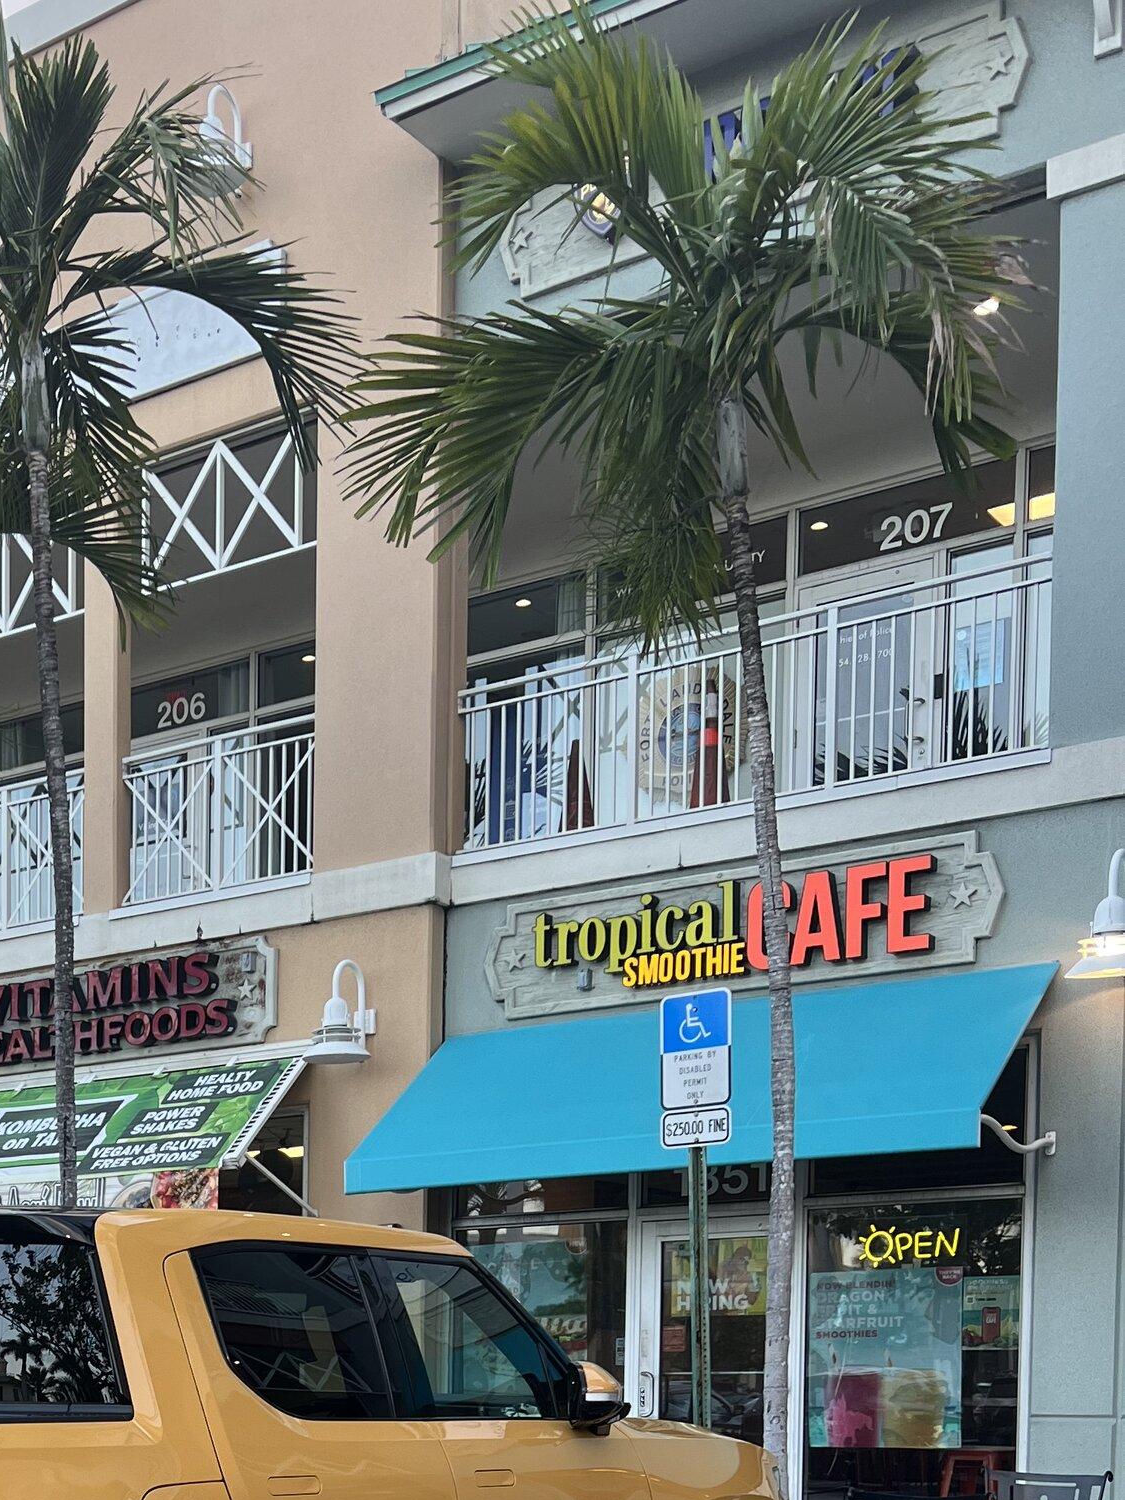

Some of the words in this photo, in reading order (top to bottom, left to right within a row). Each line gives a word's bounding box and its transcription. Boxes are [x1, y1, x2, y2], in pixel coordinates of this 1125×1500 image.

[879, 502, 953, 552] 207
[157, 692, 206, 729] 206
[746, 854, 934, 971] CAFE
[532, 880, 739, 973] tropical
[622, 941, 745, 987] SMOOTHIE
[674, 1052, 703, 1063] PARKING
[707, 1050, 717, 1058] BY
[195, 1069, 257, 1087] HEALTY
[679, 1064, 712, 1075] DISABLED
[167, 1087, 215, 1101] HOME
[217, 1080, 264, 1094] FOOD
[683, 1077, 707, 1087] PERMIT
[687, 1090, 704, 1100] ONLY
[142, 1106, 206, 1121] POWER
[130, 1118, 199, 1135] SHAKES
[666, 1120, 704, 1137] $250.00
[708, 1117, 726, 1133] FINE
[2, 1138, 31, 1151] on
[91, 1142, 143, 1159] VEGAN
[143, 1144, 159, 1155] &
[160, 1137, 222, 1151] GLUTEN
[90, 1157, 131, 1171] FREE
[131, 1151, 202, 1166] OPTIONS
[861, 1226, 960, 1266] OPEN
[677, 1278, 730, 1295] NW
[677, 1293, 749, 1311] HING
[816, 1329, 878, 1339] SMOOTHIES
